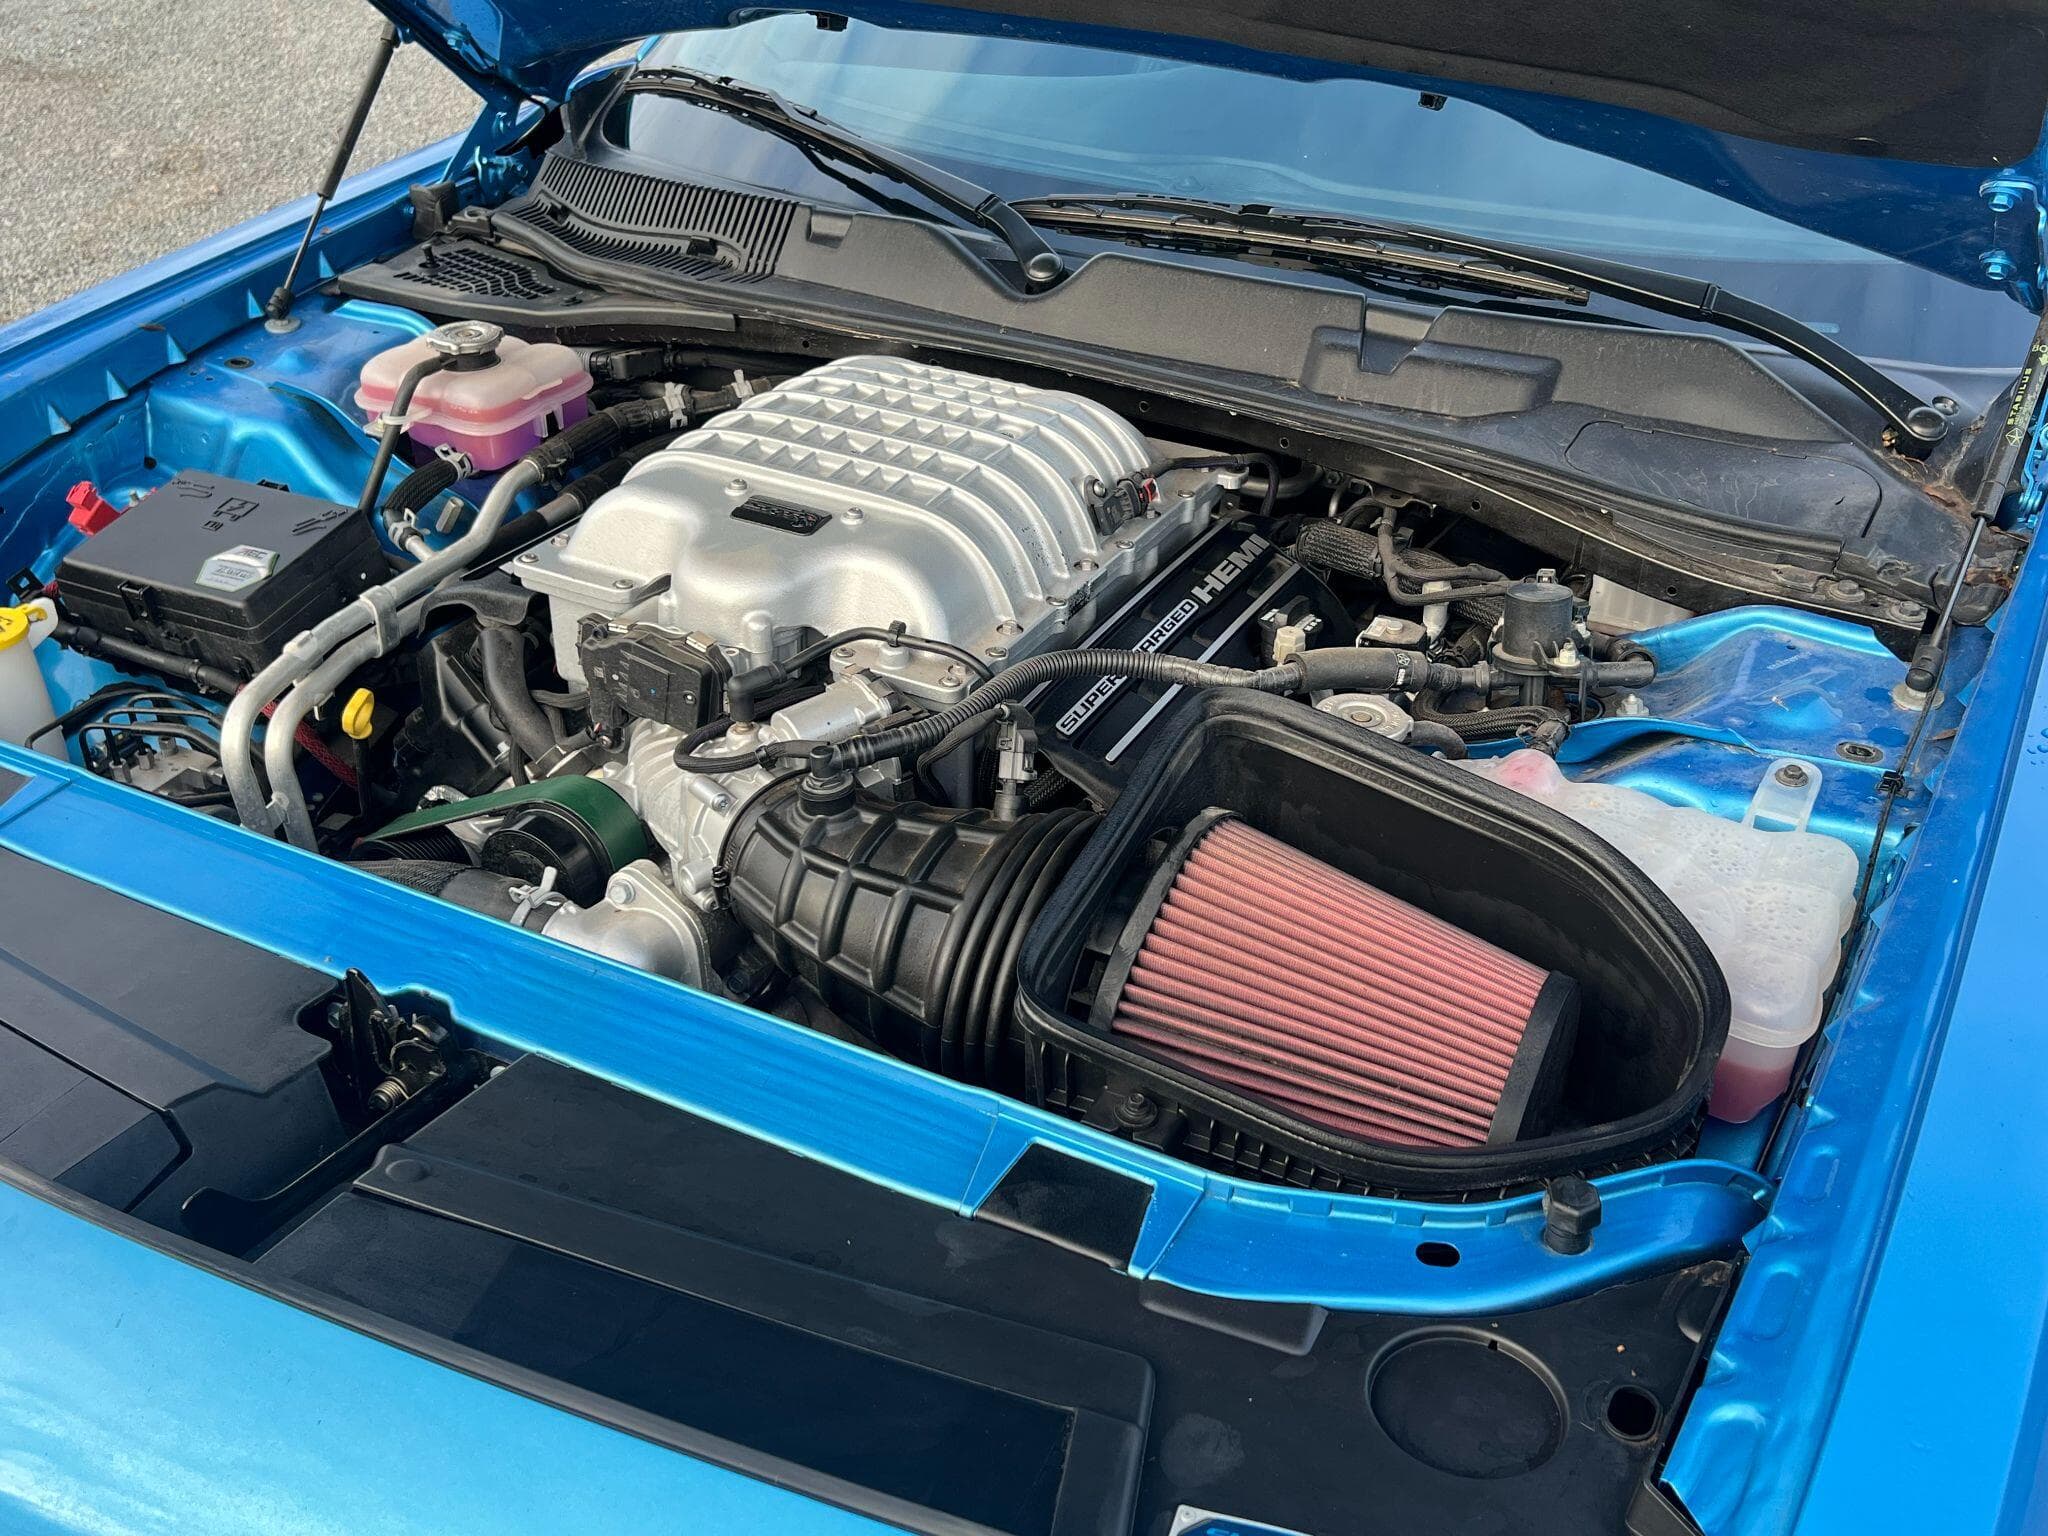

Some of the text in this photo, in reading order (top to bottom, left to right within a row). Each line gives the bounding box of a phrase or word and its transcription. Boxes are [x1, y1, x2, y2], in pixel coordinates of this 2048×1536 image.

[2007, 368, 2032, 426] STABILUS
[1060, 533, 1271, 732] SUPERARGED HEMI
